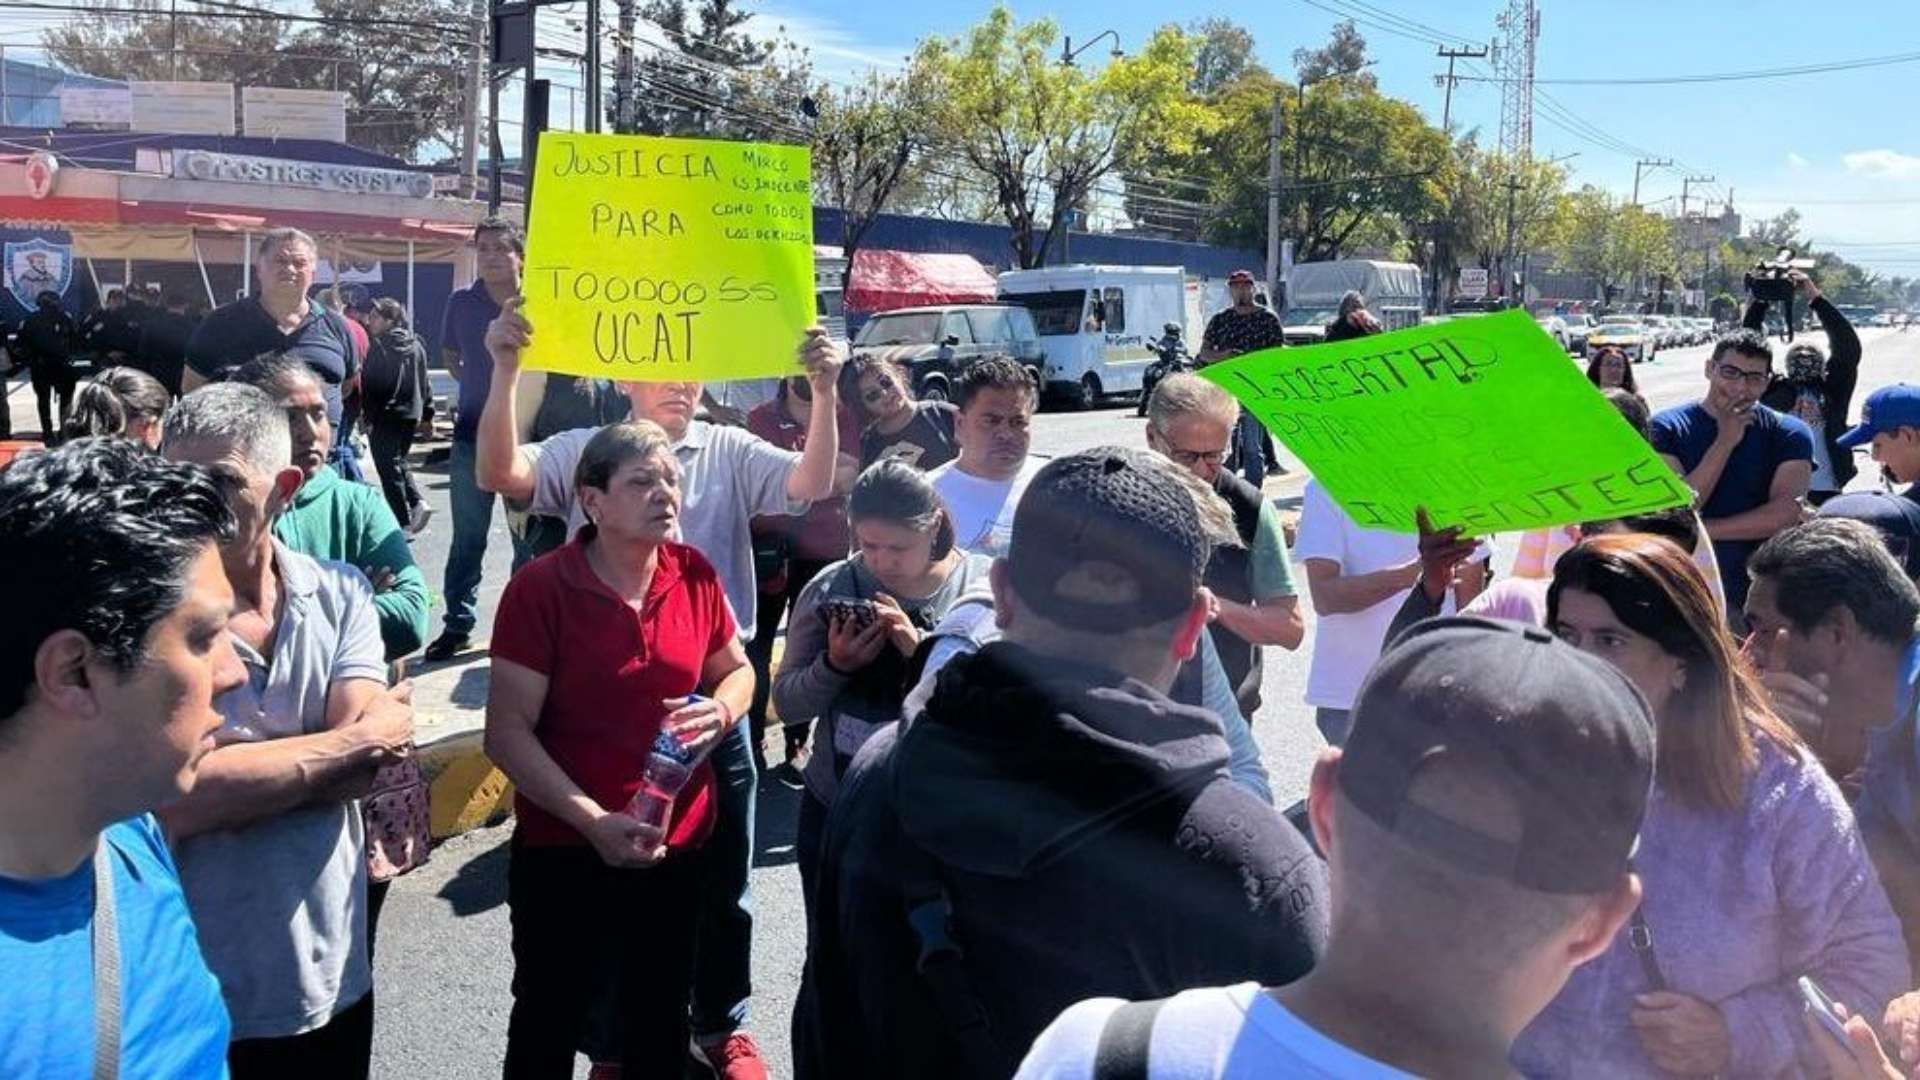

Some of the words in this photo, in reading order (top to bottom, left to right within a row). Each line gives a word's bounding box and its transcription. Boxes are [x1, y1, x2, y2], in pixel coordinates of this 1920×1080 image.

[553, 142, 719, 180] JUSTICIA
[591, 202, 687, 239] PARA
[711, 202, 754, 217] COMO
[764, 203, 805, 220] TODOS
[1233, 336, 1500, 404] LIBERTAD
